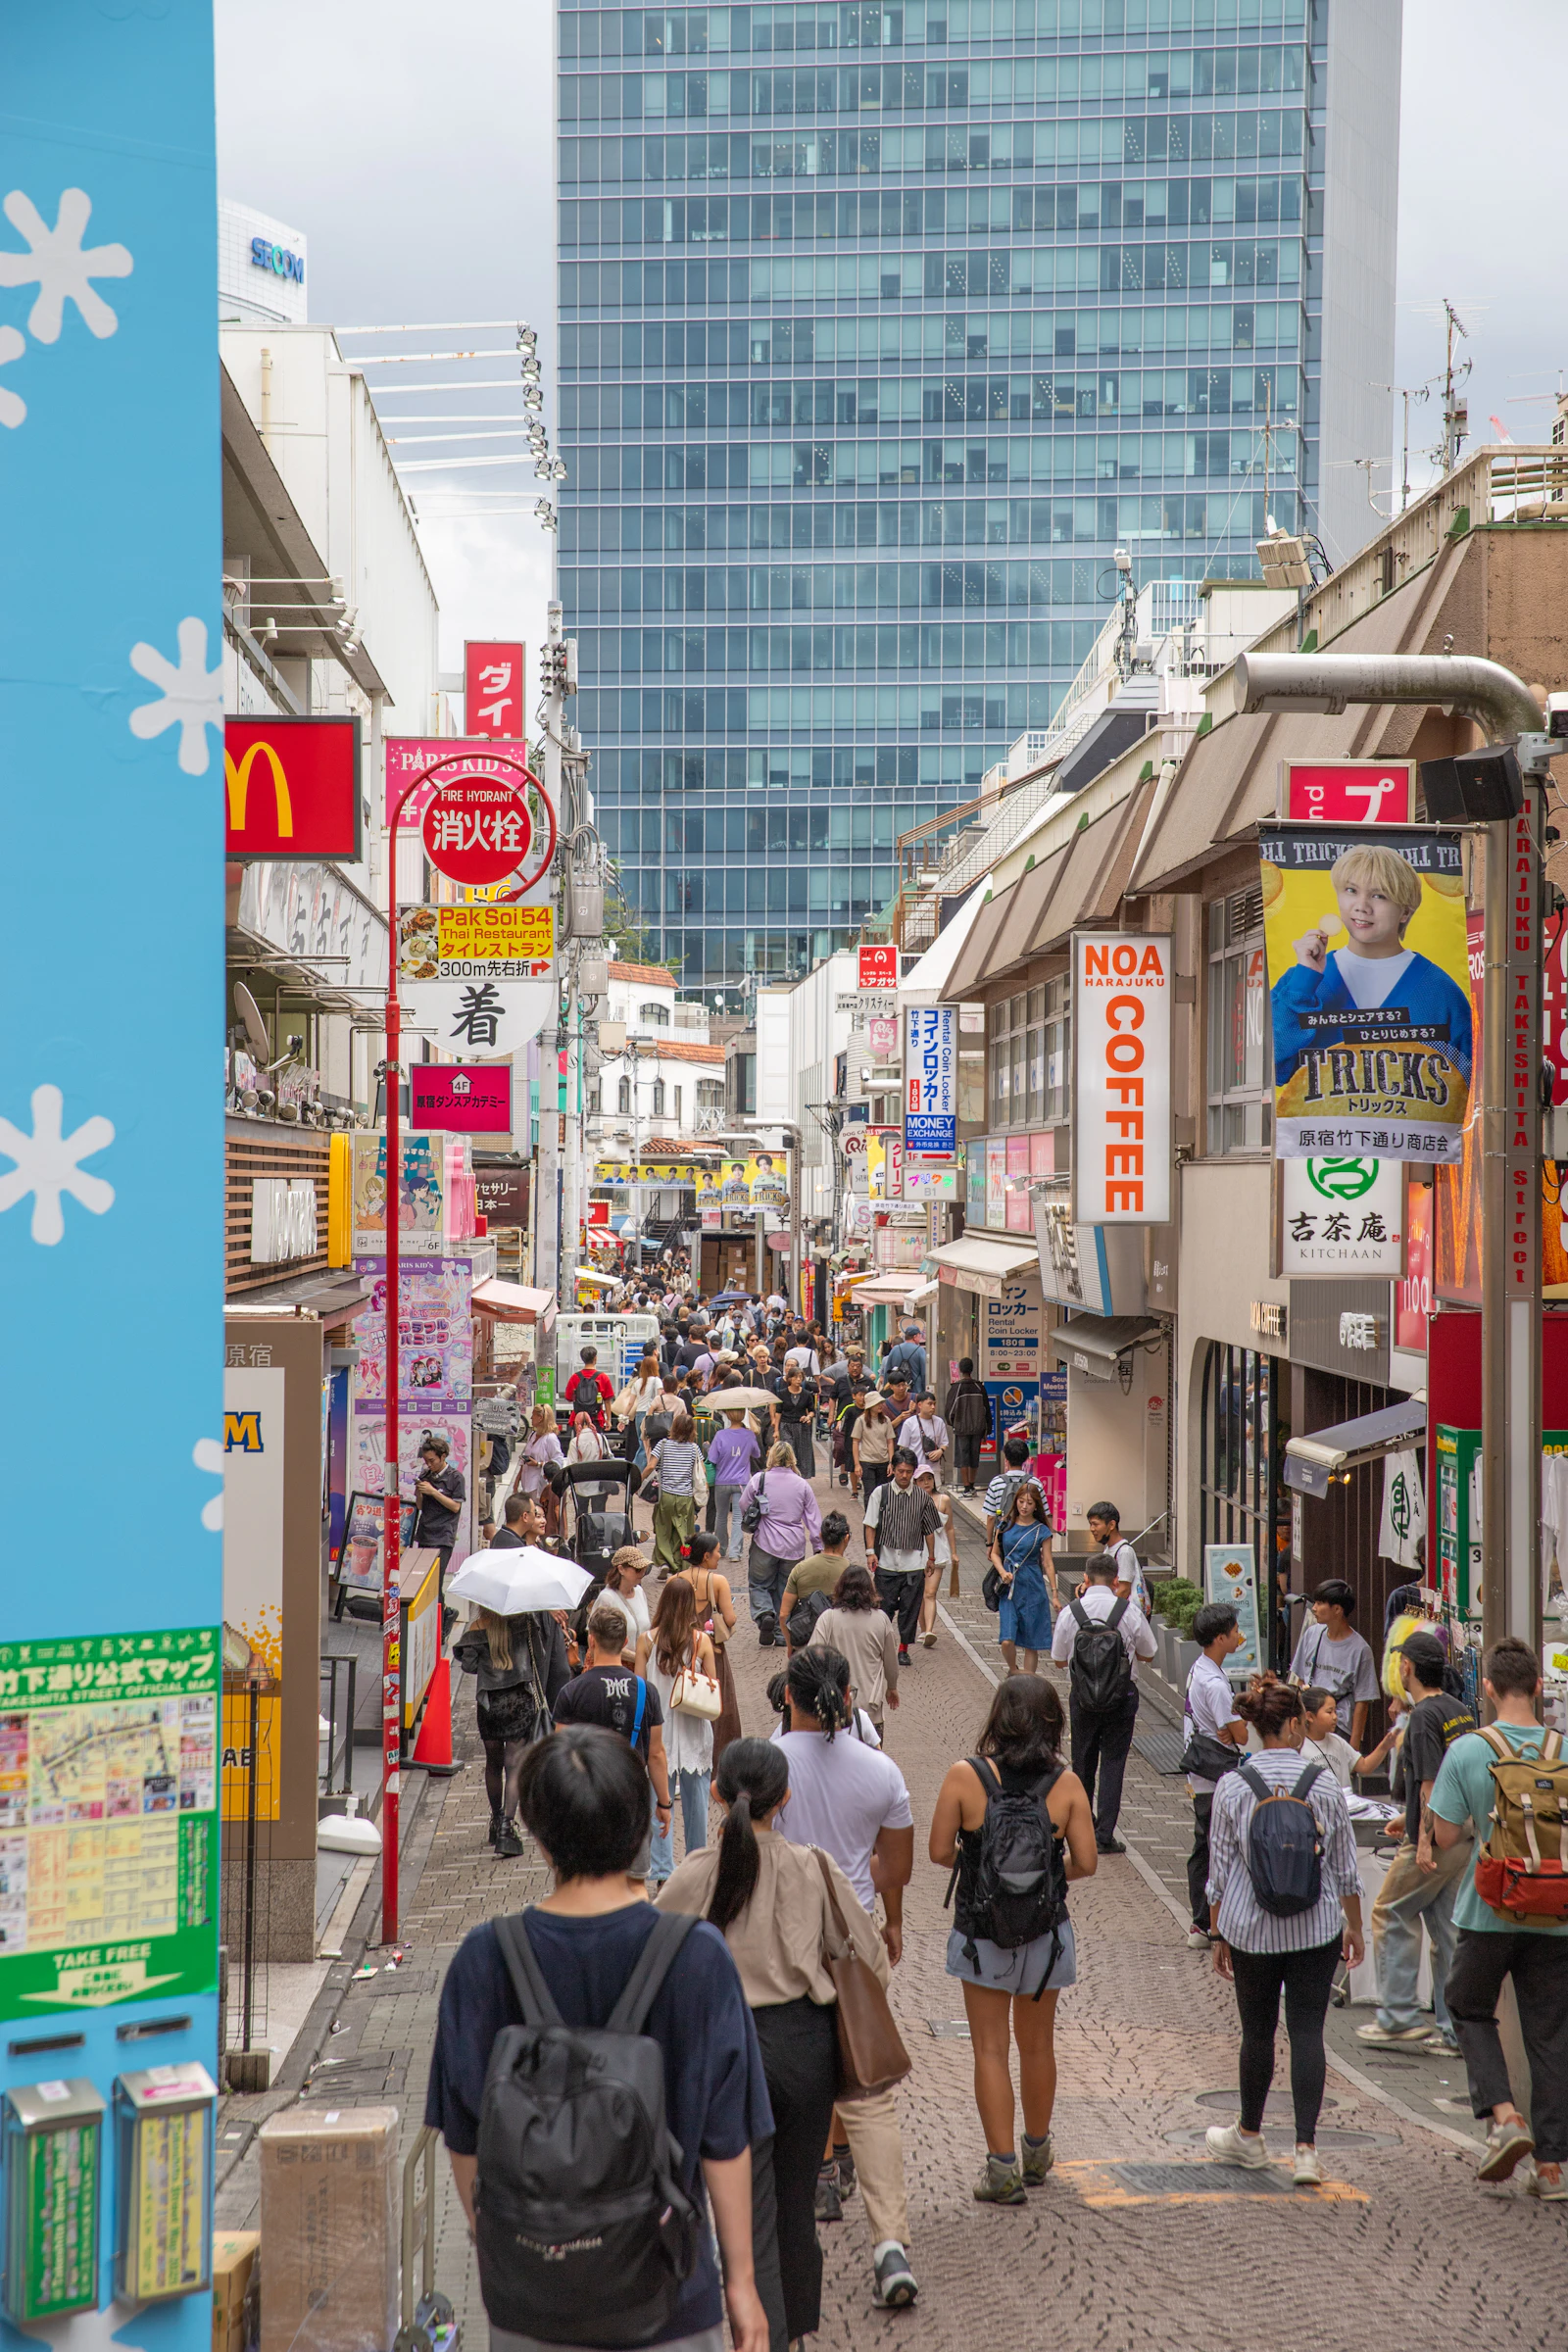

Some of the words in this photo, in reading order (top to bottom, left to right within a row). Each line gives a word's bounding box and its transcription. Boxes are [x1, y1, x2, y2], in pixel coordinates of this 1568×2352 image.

[252, 237, 305, 284] SECOM
[441, 789, 464, 802] FIRE
[466, 790, 514, 804] HYDRANT
[432, 809, 524, 852] 消火栓
[1515, 799, 1532, 952] HARAJUKU
[440, 907, 480, 926] Pak
[484, 907, 517, 926] Soi
[520, 908, 552, 926] 54
[441, 928, 470, 939] Thai
[474, 928, 552, 940] Restaurant
[441, 942, 552, 957] タイレストラン
[440, 960, 530, 977] 300m先右折
[1086, 945, 1164, 976] NOA
[867, 978, 897, 987] アガサ
[1086, 978, 1165, 988] HARAJUKU
[858, 998, 894, 1010] クリスティー
[450, 983, 506, 1047] 着
[1308, 1010, 1402, 1026] みんなとシェアする?
[873, 1021, 894, 1034] Rio
[942, 1010, 952, 1045] Rental
[1360, 1027, 1436, 1041] ひとりじめする?
[923, 1010, 939, 1112] コインロッカー
[942, 1048, 952, 1072] Coin
[1514, 975, 1530, 1147] TAKESHITA
[1298, 1049, 1450, 1106] TRICKS
[454, 1080, 468, 1093] 4F
[942, 1076, 952, 1112] Locker
[416, 1095, 507, 1109] 原宿ダンスアカデミー
[1105, 995, 1145, 1213] COFFEE
[1348, 1098, 1407, 1115] トリックス
[906, 1117, 955, 1129] MONEY
[1298, 1129, 1449, 1152] 原宿竹下通り商店会
[907, 1152, 918, 1161] 1F
[907, 1173, 954, 1188] プリクラ
[755, 1191, 782, 1202] TRICKS
[924, 1187, 937, 1196] B1
[1287, 1211, 1388, 1244] 吉茶庵
[1513, 1170, 1529, 1284] Street
[427, 1242, 440, 1250] 6F
[1299, 1249, 1382, 1259] KITCHAAN
[989, 1302, 1039, 1316] ロッカー
[224, 1343, 272, 1368] 原宿
[1217, 1597, 1250, 1607] Morning
[0, 1690, 69, 1708] AKESHITA
[72, 1687, 123, 1701] STREET
[125, 1682, 184, 1696] OFFICIAL
[186, 1678, 216, 1691] MAP
[53, 1949, 101, 1971] TAKE
[106, 1942, 152, 1963] FREE
